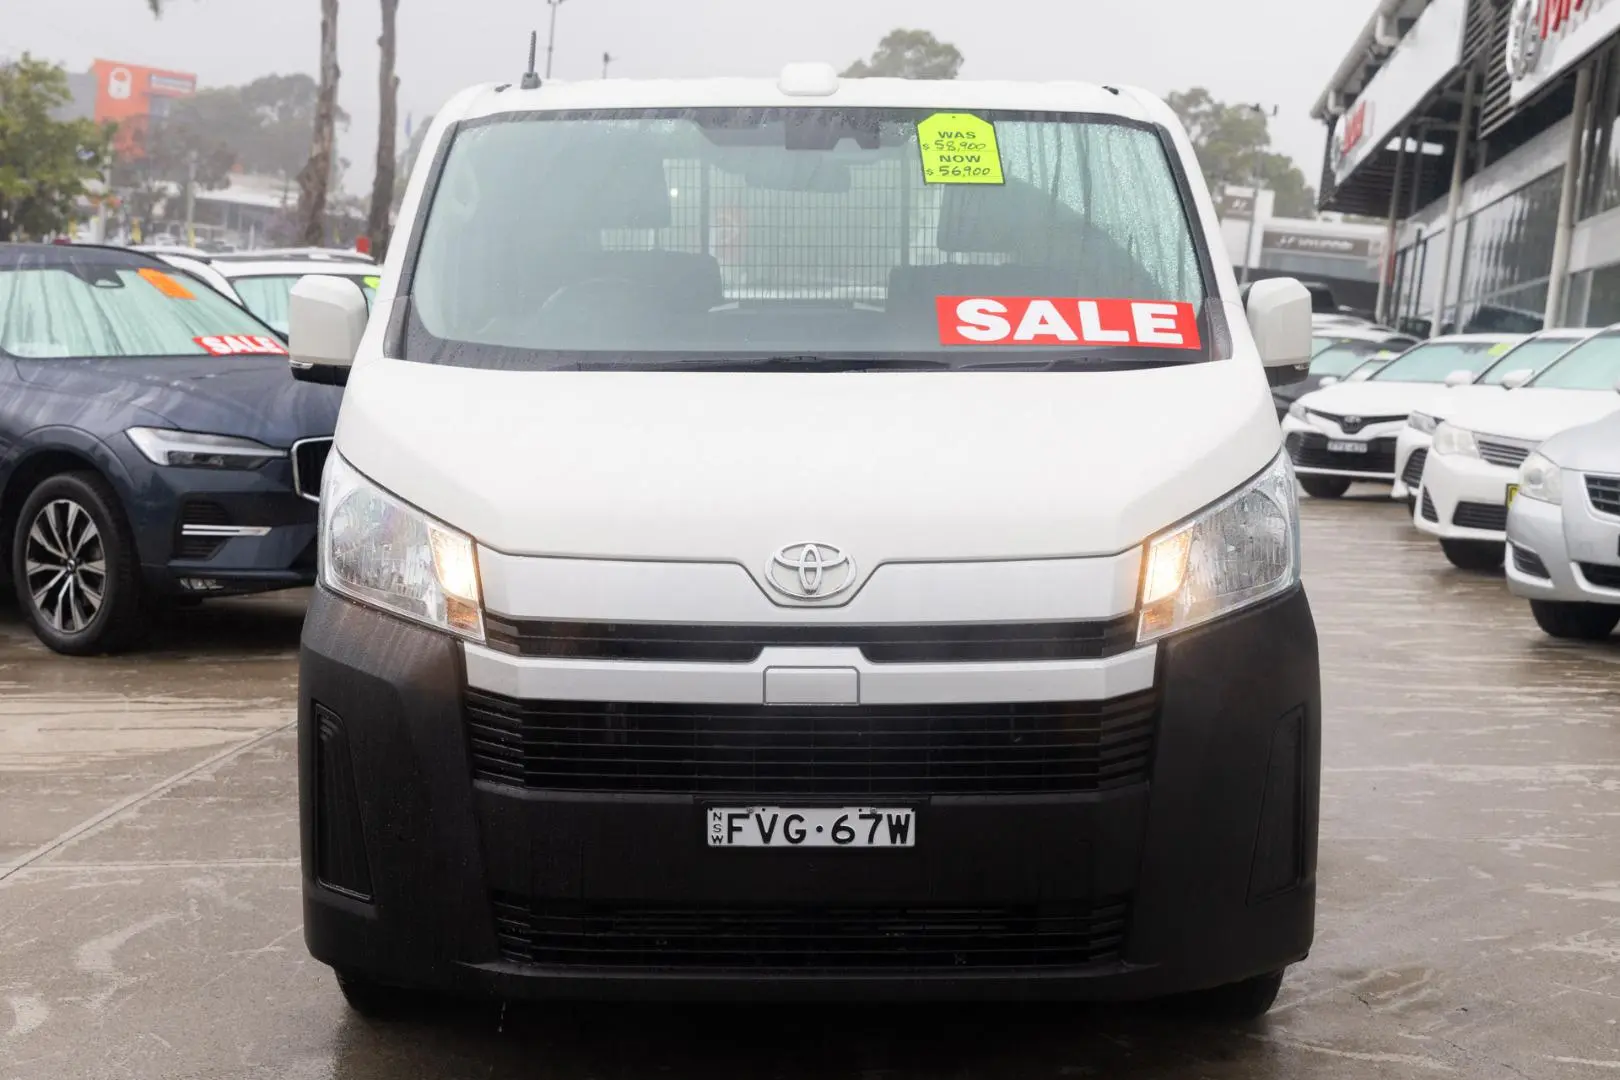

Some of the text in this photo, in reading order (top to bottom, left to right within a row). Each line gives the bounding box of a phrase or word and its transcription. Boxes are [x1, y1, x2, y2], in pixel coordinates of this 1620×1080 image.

[938, 131, 976, 139] WAS
[934, 139, 987, 152] 58,900
[939, 154, 981, 163] NOW
[938, 165, 991, 177] 56,900
[956, 299, 1184, 345] SALE
[201, 336, 285, 354] SALE
[711, 811, 724, 844] NSW
